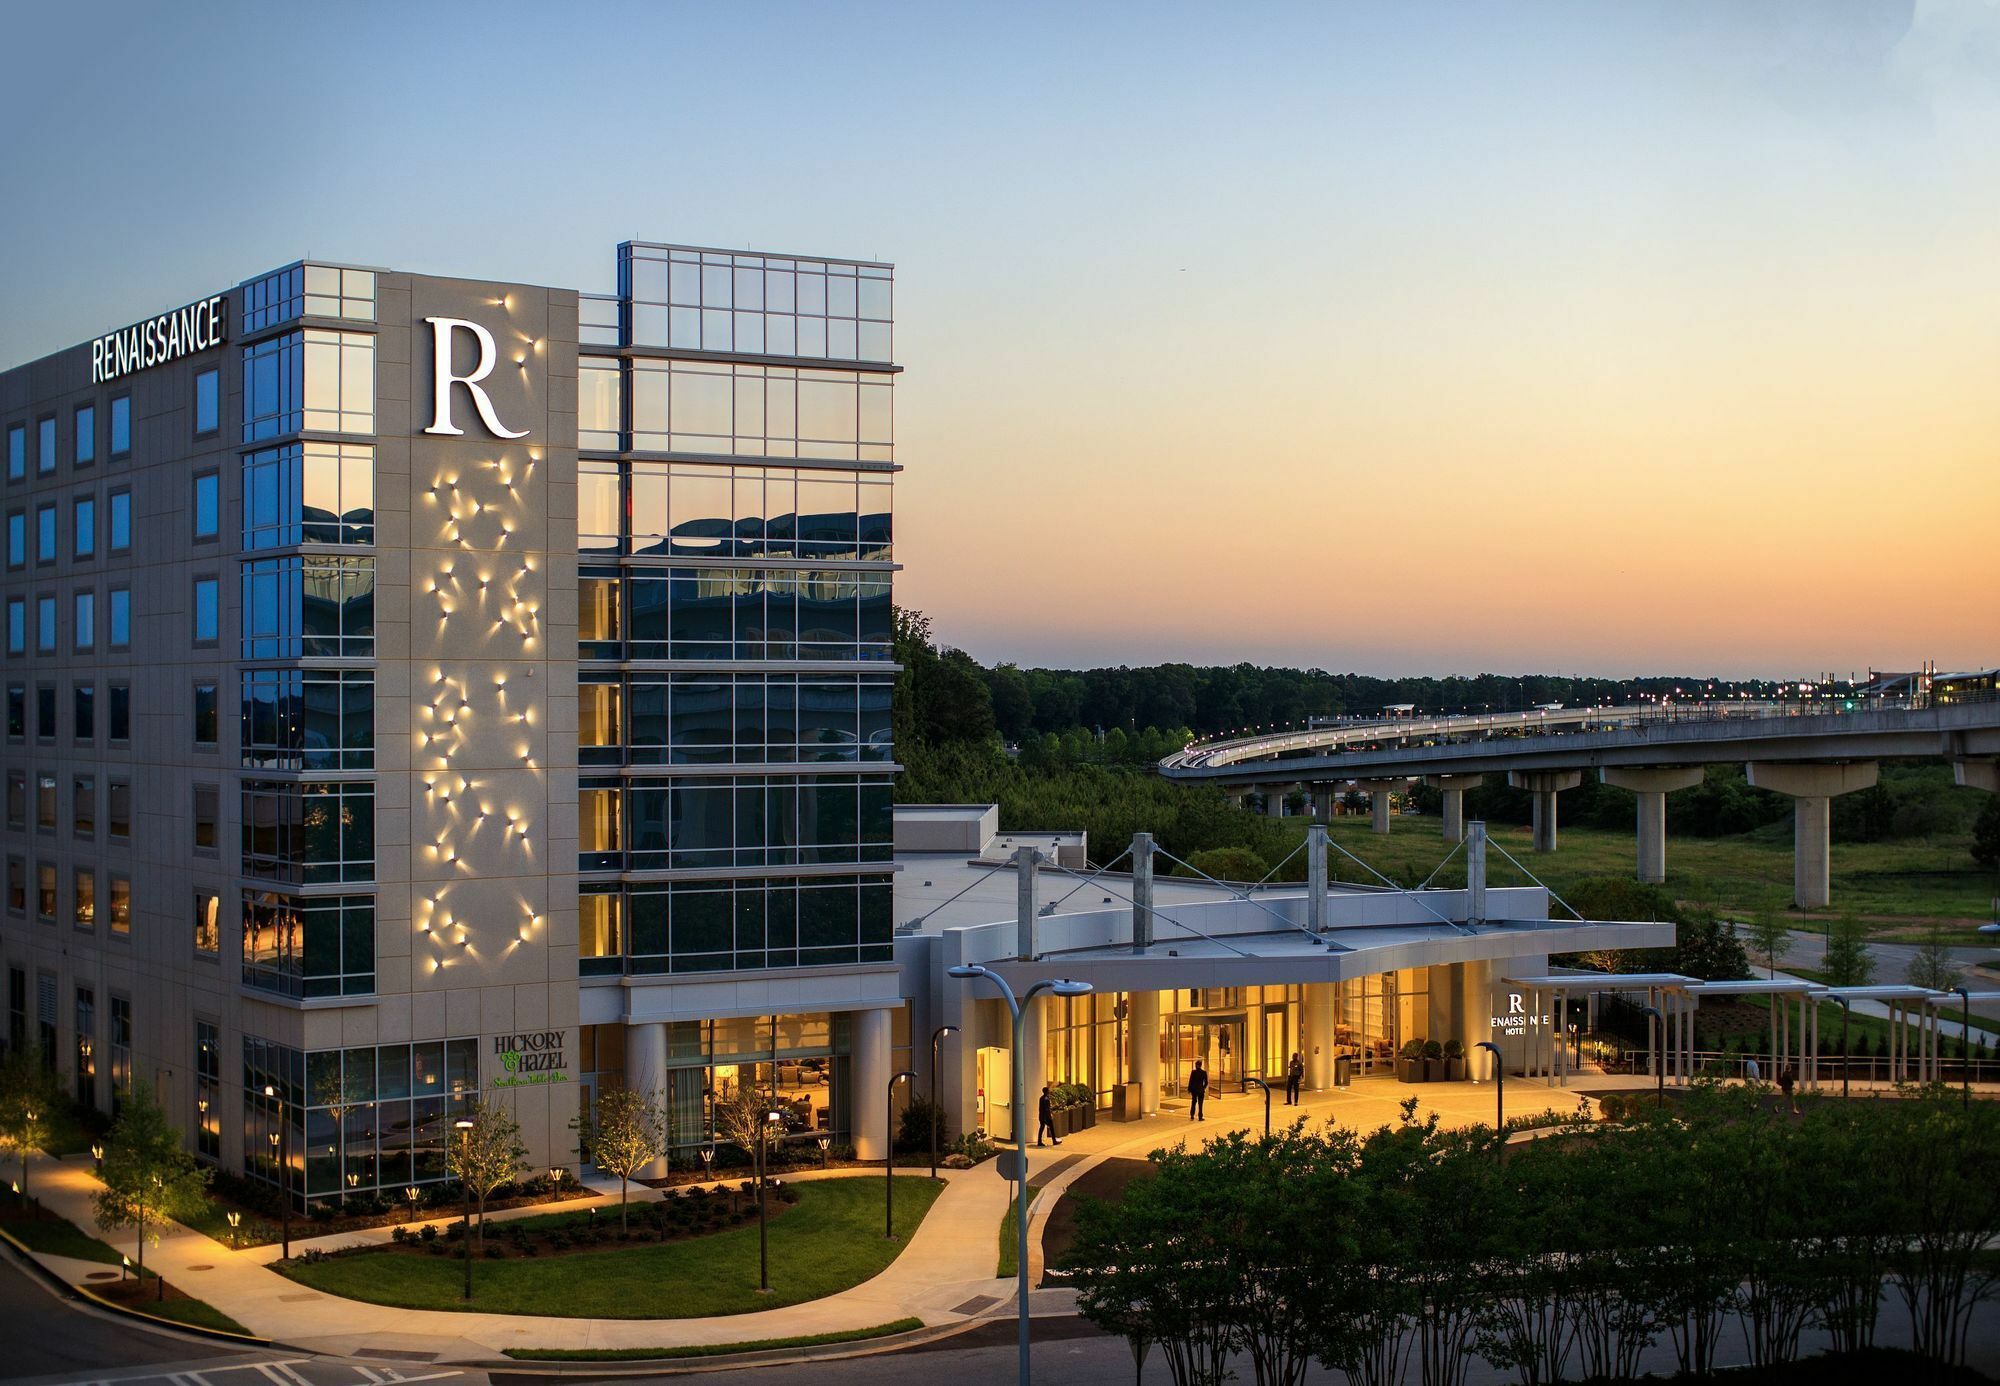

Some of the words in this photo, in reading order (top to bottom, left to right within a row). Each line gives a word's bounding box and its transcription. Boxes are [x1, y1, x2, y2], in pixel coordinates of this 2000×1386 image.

[92, 296, 222, 384] RENAISSANCE
[424, 316, 531, 439] R
[1509, 993, 1525, 1013] R
[494, 1031, 566, 1054] HICKORY
